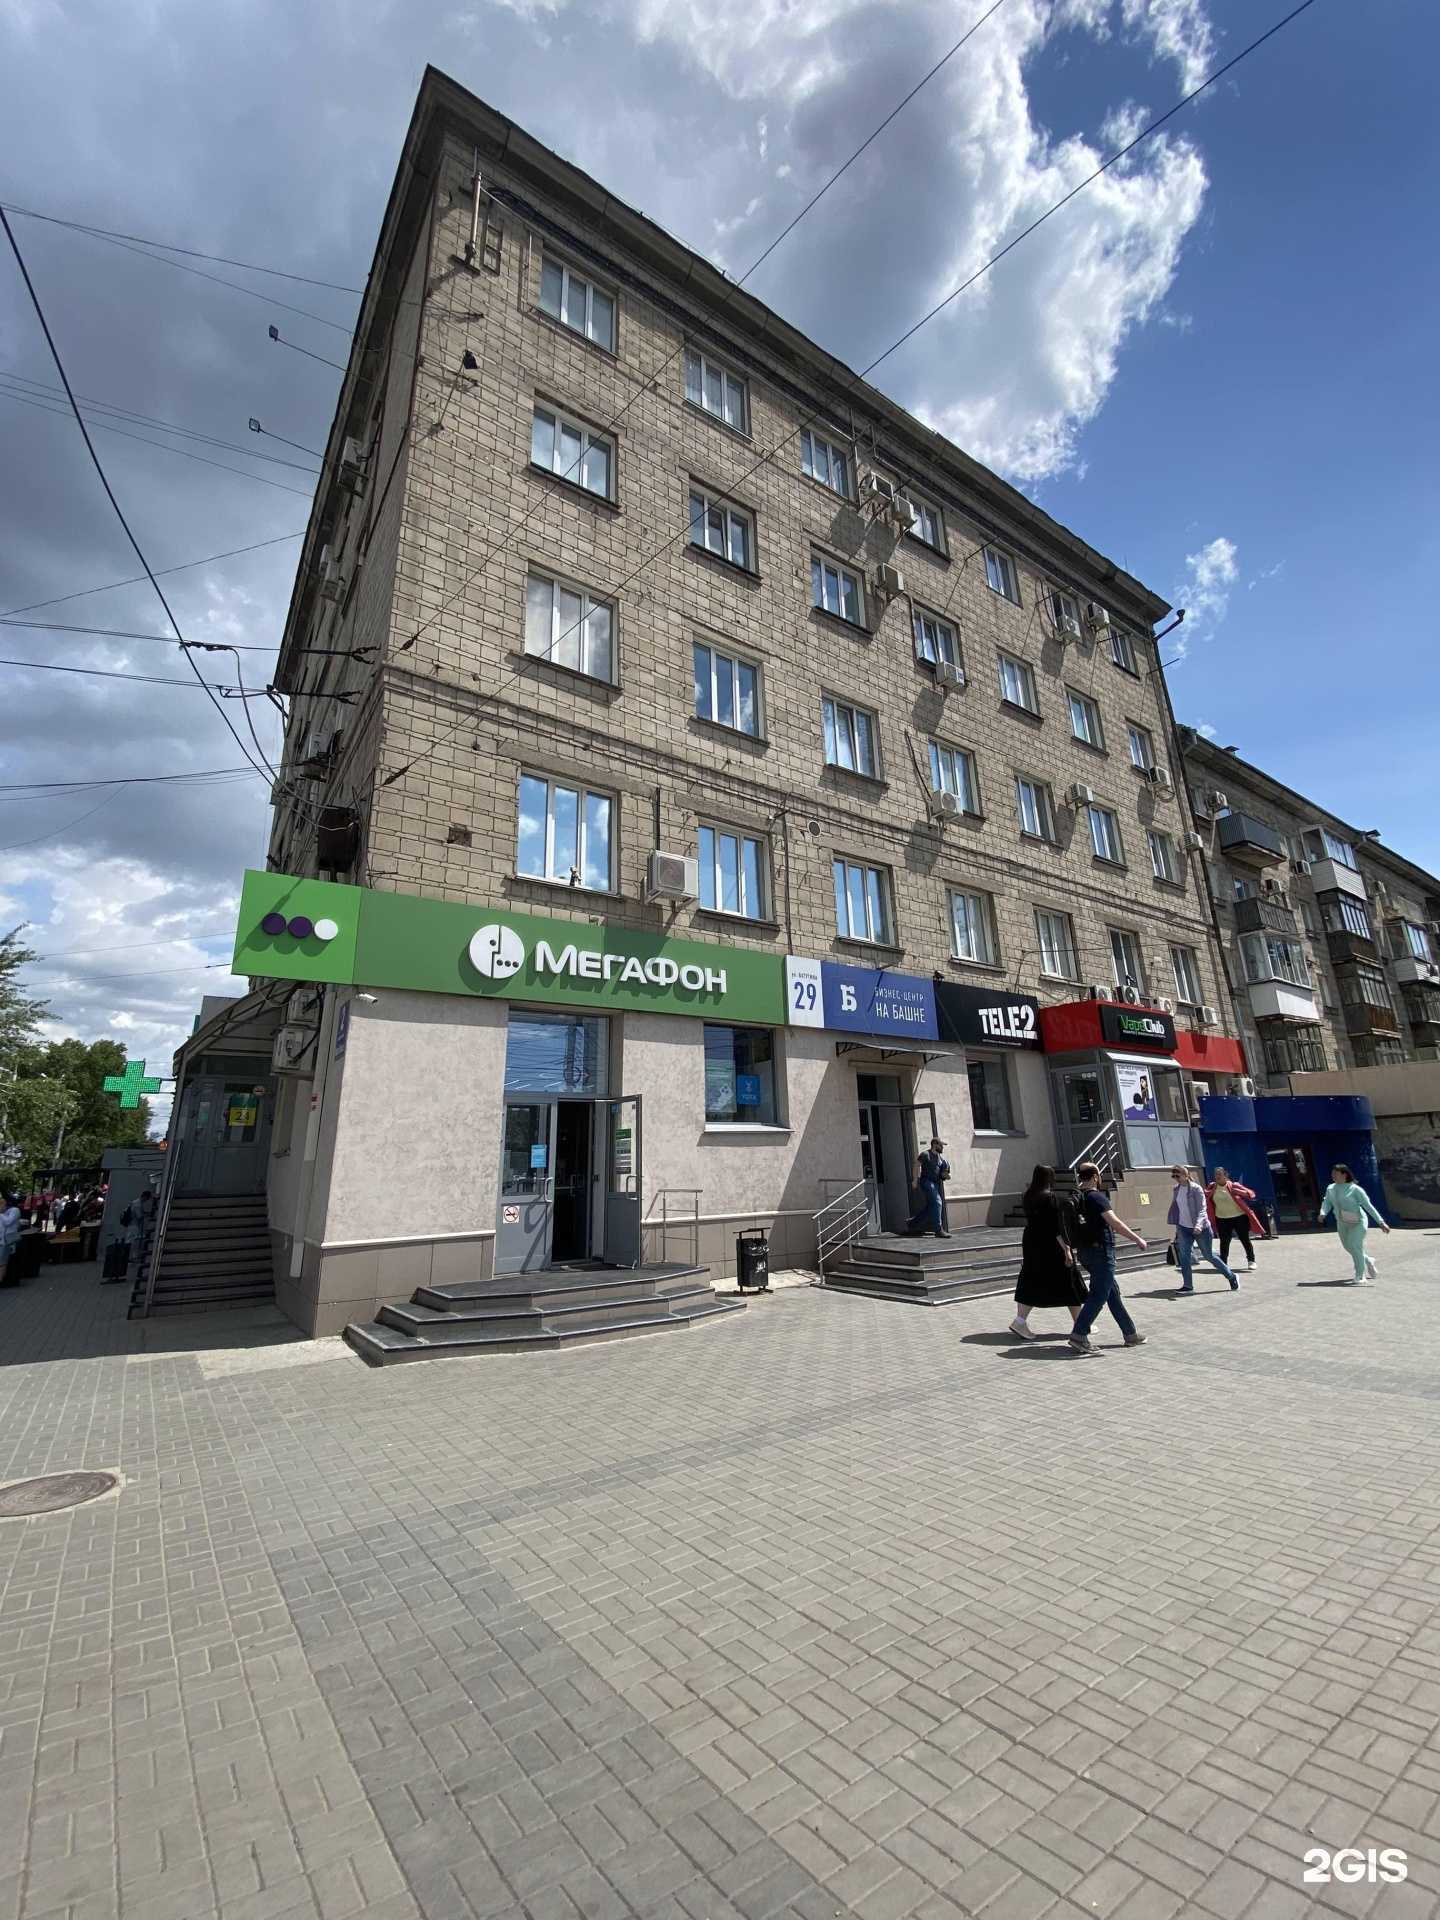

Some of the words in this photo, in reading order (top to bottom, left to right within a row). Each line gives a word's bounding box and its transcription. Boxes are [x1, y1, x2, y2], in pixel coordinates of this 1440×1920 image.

[534, 940, 728, 993] МЕГАФОН
[794, 981, 817, 1011] 29
[840, 984, 857, 1012] Б
[875, 1002, 889, 1018] НА
[892, 1004, 926, 1023] БАШНЕ
[978, 1004, 1038, 1040] TELE2
